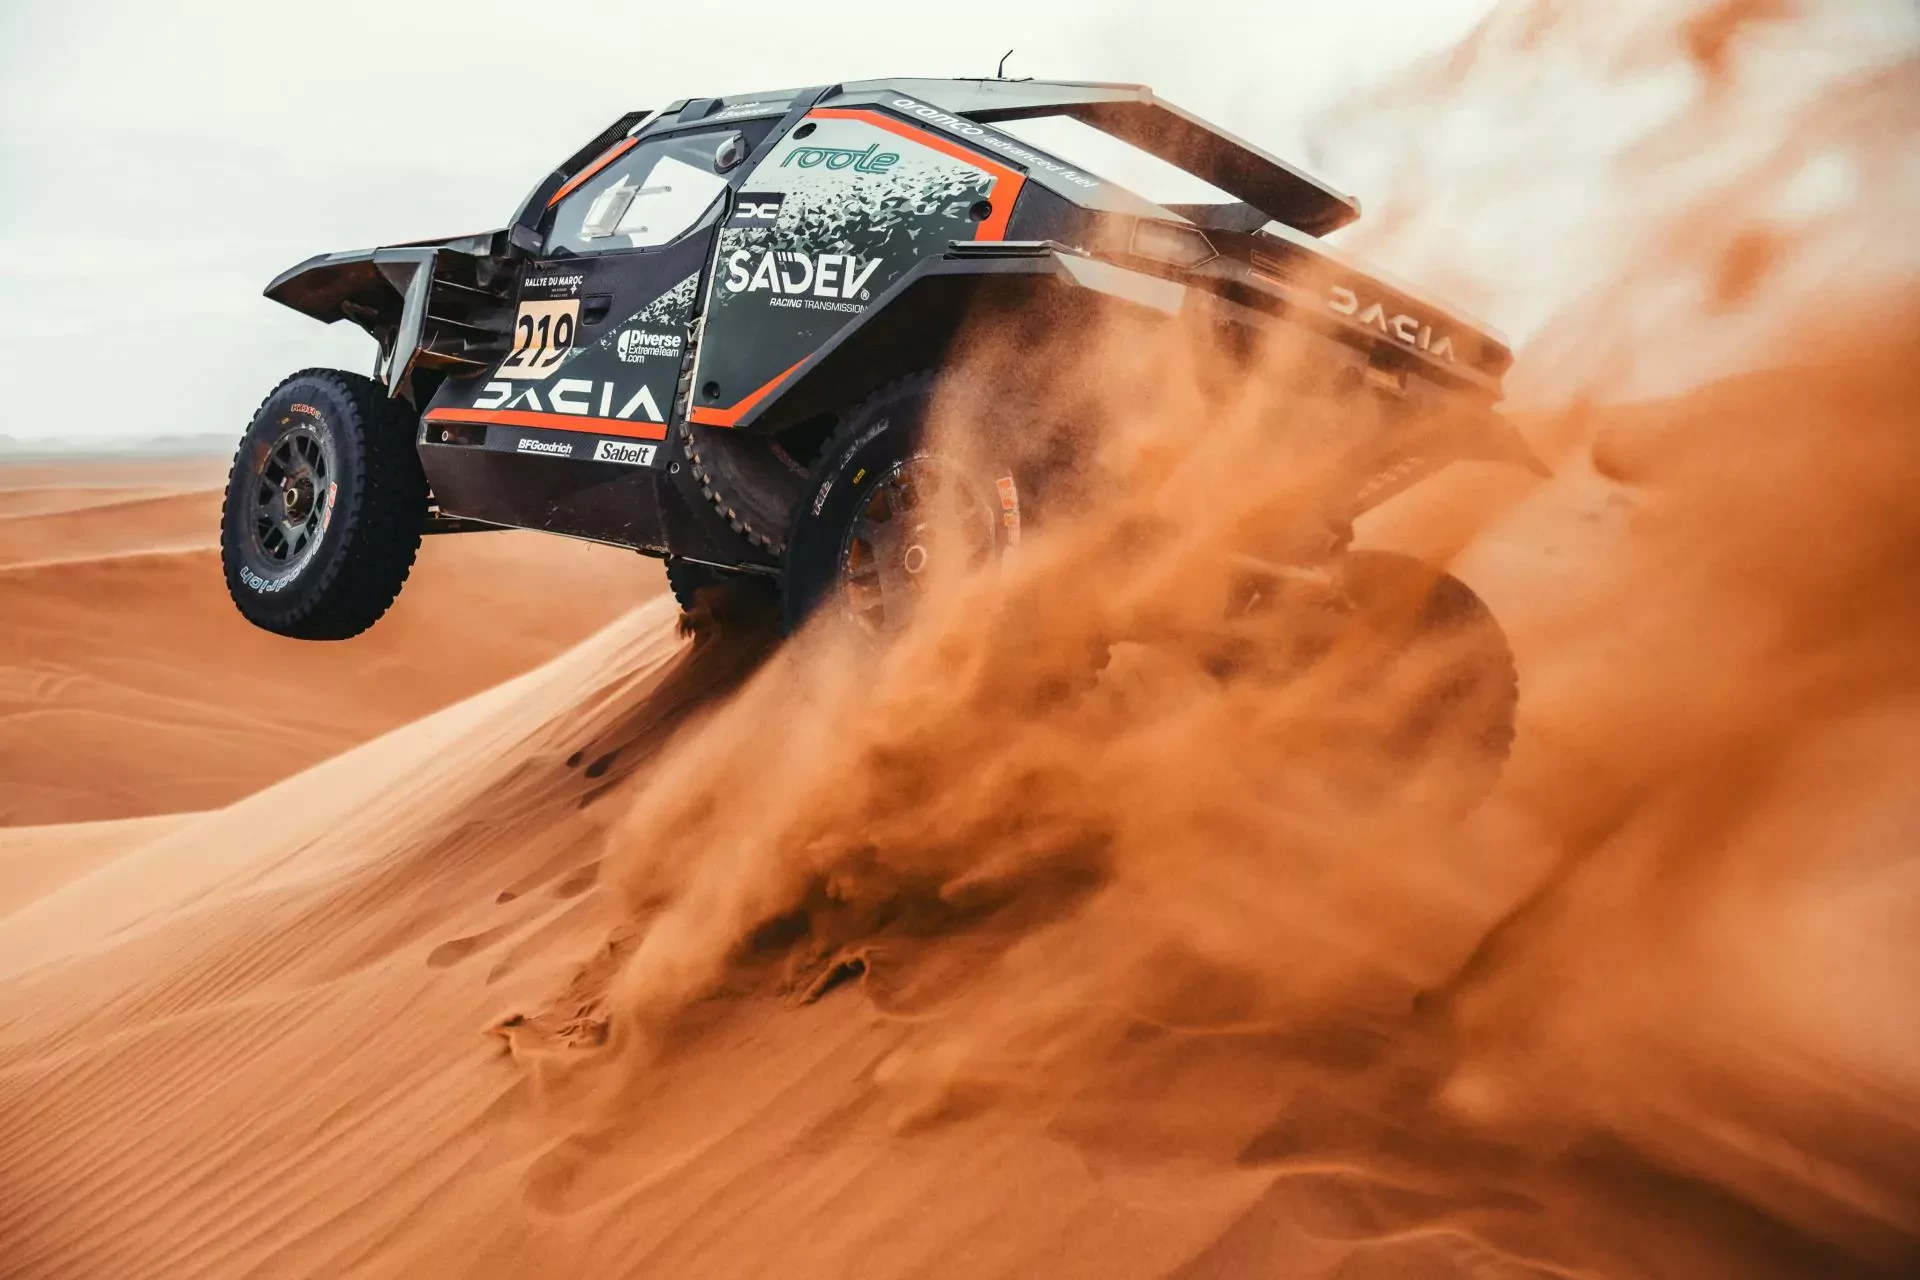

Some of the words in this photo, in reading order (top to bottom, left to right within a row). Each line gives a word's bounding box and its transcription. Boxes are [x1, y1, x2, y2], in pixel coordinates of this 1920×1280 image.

[892, 99, 984, 136] aramco
[984, 137, 1065, 172] advanced
[1058, 170, 1099, 188] fuel
[780, 143, 900, 175] roole
[524, 277, 548, 287] RALLYE
[548, 276, 559, 286] DU
[558, 275, 583, 286] MAROC
[769, 297, 802, 308] RACING
[1328, 284, 1454, 362] DACIA
[503, 313, 574, 368] 219
[630, 329, 682, 348] Diverse
[626, 354, 645, 364] .com
[628, 344, 679, 357] ExtremeTeam
[472, 378, 665, 422] DACIA
[518, 438, 573, 454] BFGoodrich
[600, 442, 650, 464] Sabelt
